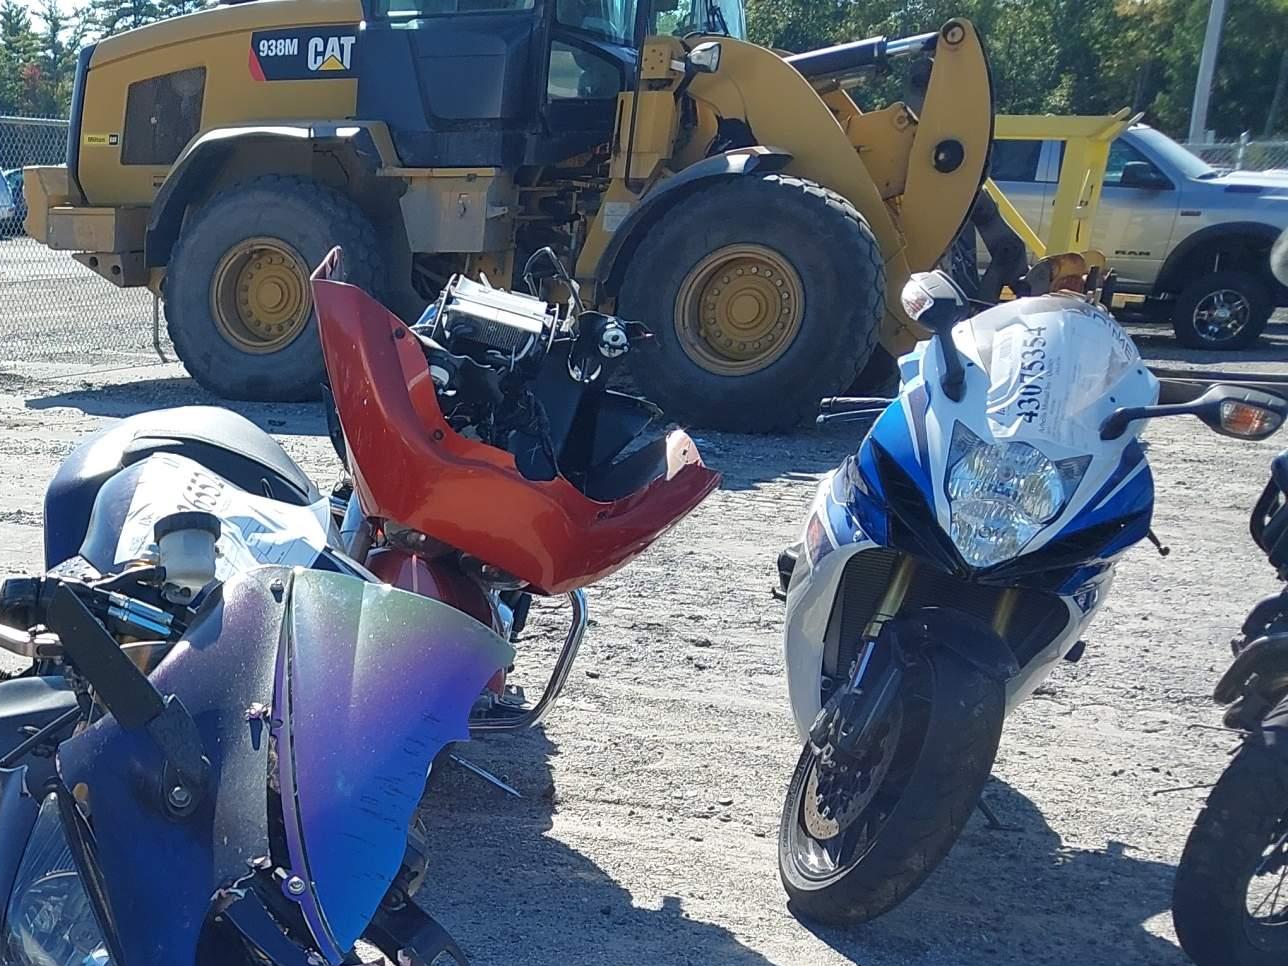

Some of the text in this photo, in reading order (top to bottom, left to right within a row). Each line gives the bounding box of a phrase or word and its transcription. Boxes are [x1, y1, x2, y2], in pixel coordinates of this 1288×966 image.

[259, 38, 299, 57] 938M
[307, 36, 356, 71] CAT
[1114, 249, 1152, 257] RAM
[1016, 325, 1048, 424] 43075354
